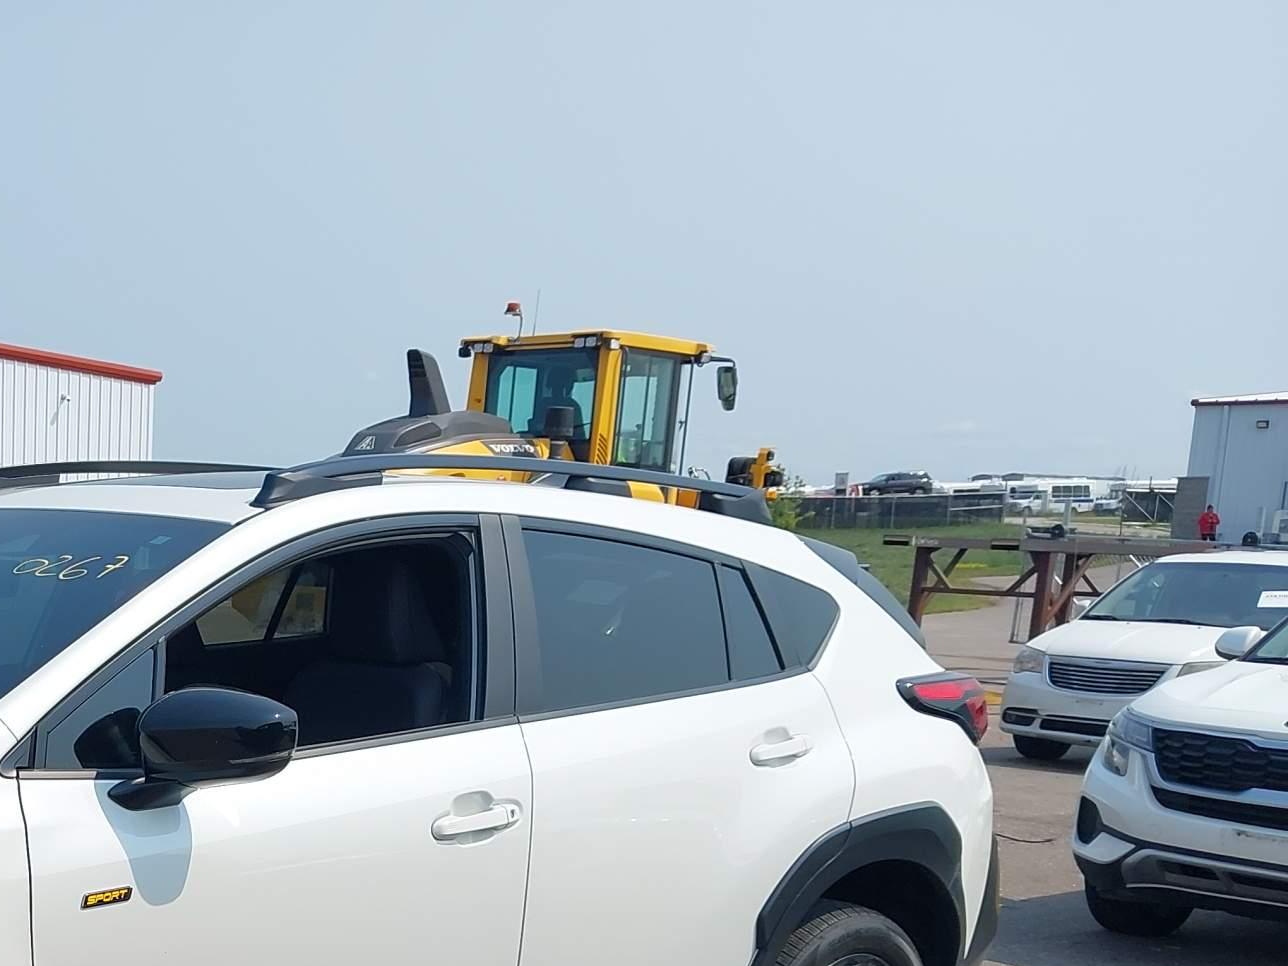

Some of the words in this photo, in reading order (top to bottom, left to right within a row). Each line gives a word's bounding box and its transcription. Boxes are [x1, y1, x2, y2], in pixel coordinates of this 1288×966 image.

[489, 444, 536, 453] VOLVO
[12, 554, 130, 581] 0267
[86, 888, 129, 906] SPORT
